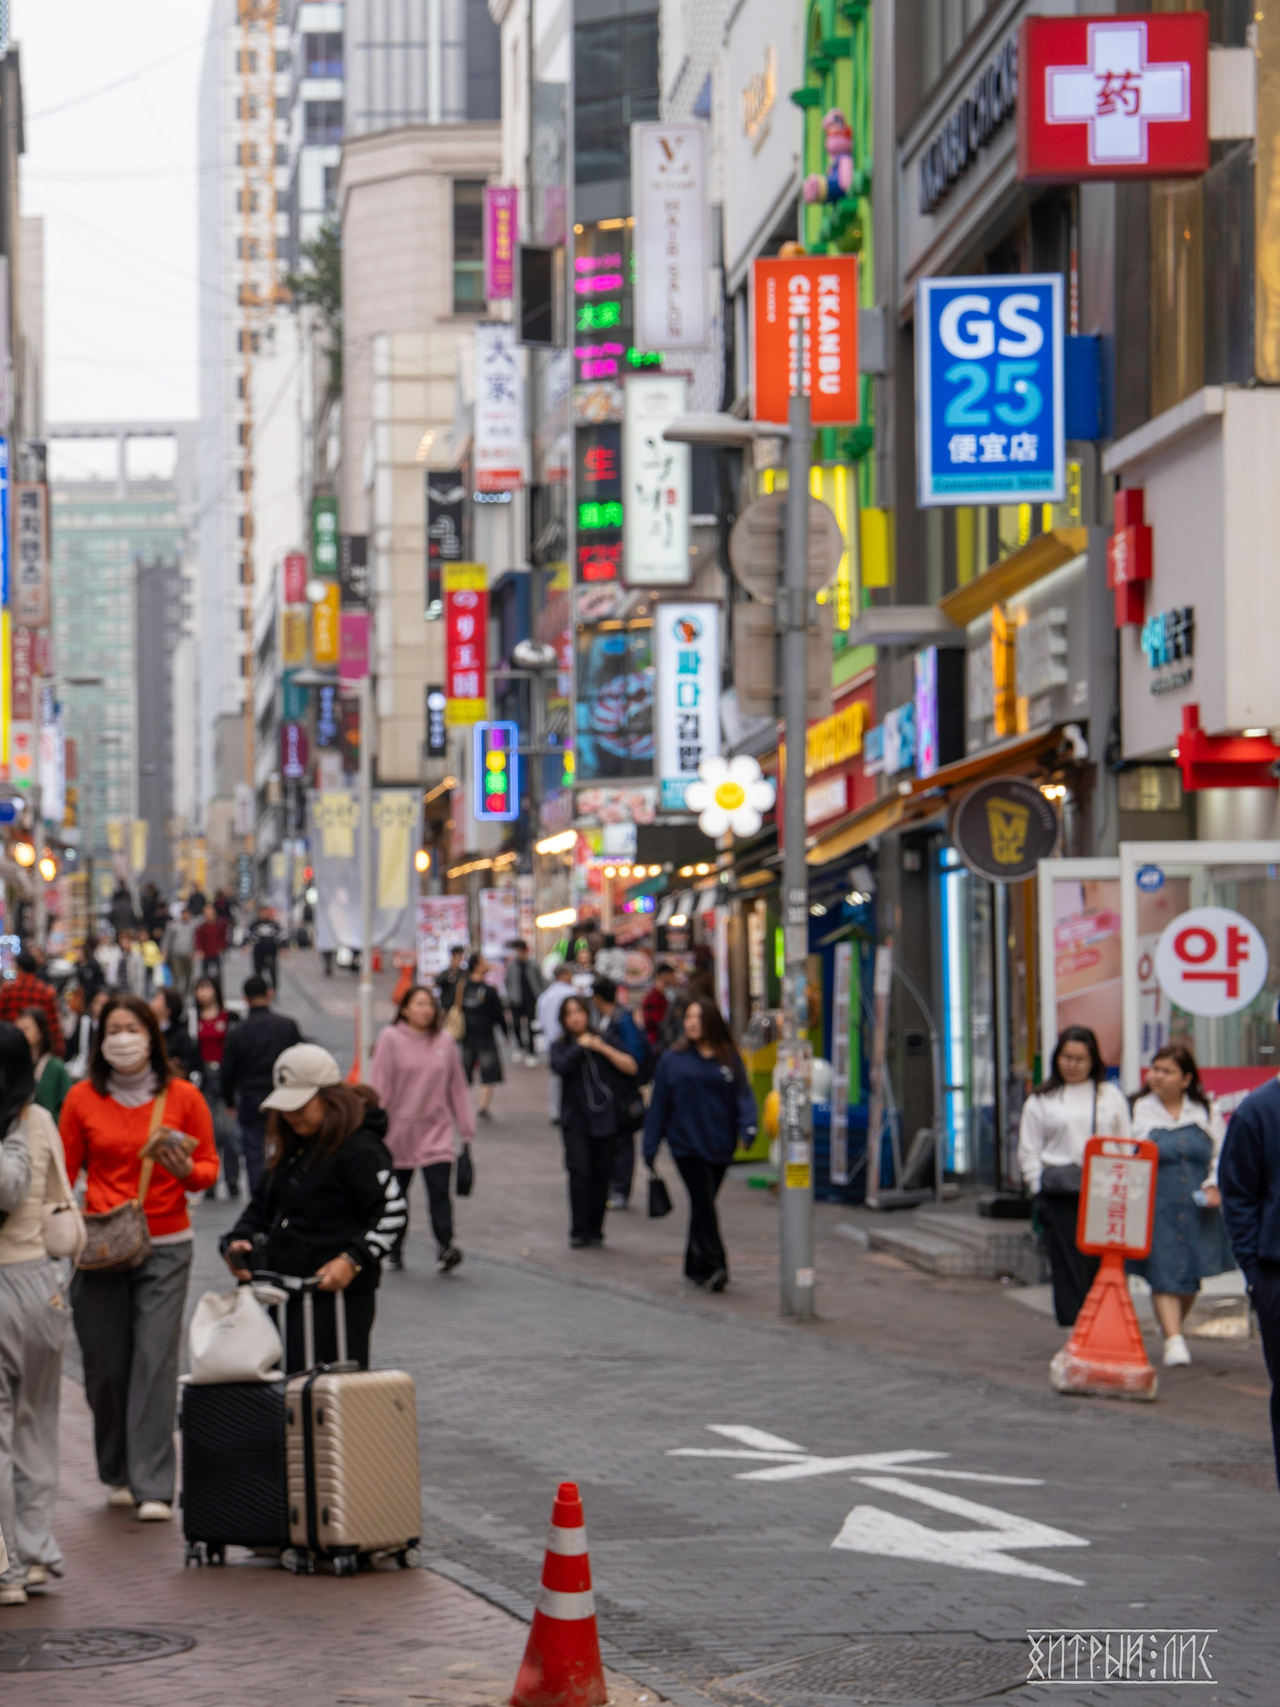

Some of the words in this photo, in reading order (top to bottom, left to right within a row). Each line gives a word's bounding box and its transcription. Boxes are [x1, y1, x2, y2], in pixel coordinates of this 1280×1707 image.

[1095, 69, 1142, 117] 药
[818, 273, 841, 395] KKANBU
[938, 293, 1045, 360] GS
[943, 360, 1044, 427] 25
[947, 432, 1039, 464] 便宜店
[935, 475, 1014, 491] Convenience
[1019, 474, 1051, 489] Store
[1174, 925, 1250, 999] 약
